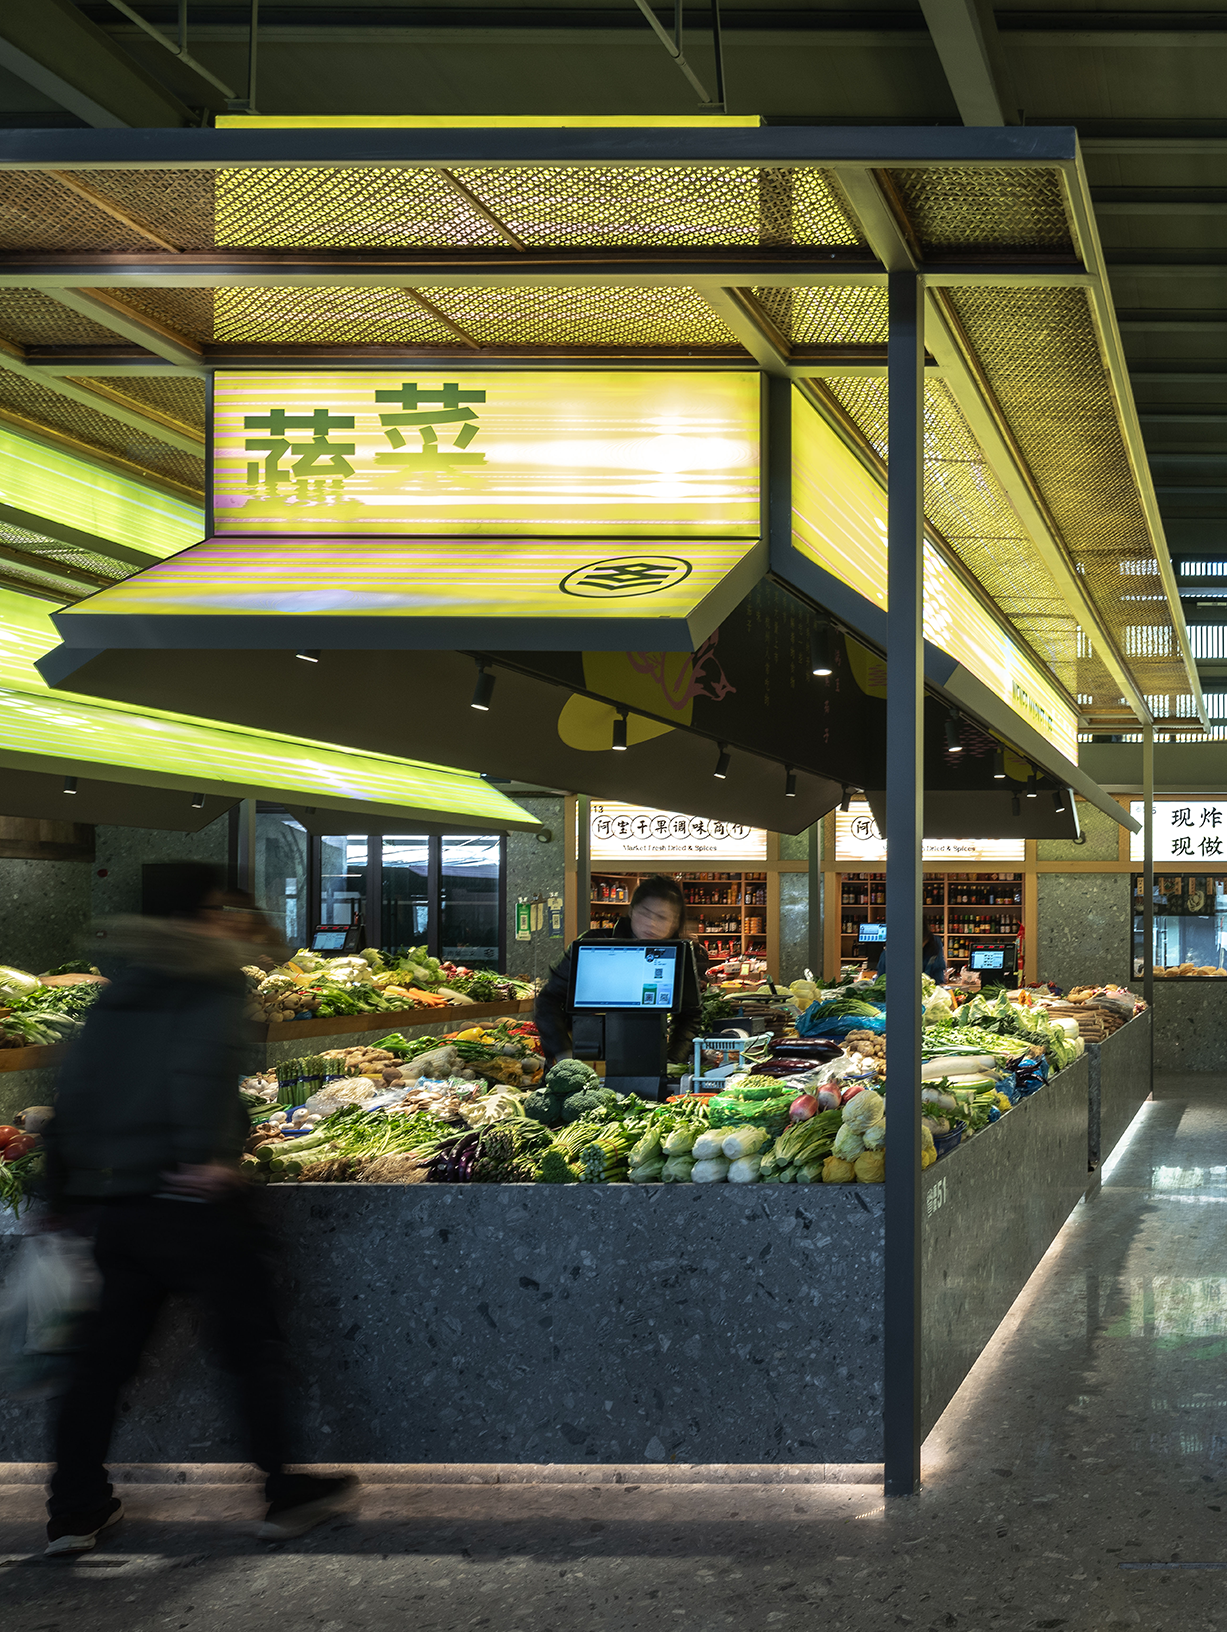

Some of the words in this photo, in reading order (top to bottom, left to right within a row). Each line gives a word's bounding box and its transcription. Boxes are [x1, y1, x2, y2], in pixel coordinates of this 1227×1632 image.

[243, 382, 487, 506] 蔬菜
[592, 805, 604, 814] 13
[694, 843, 718, 853] Spices
